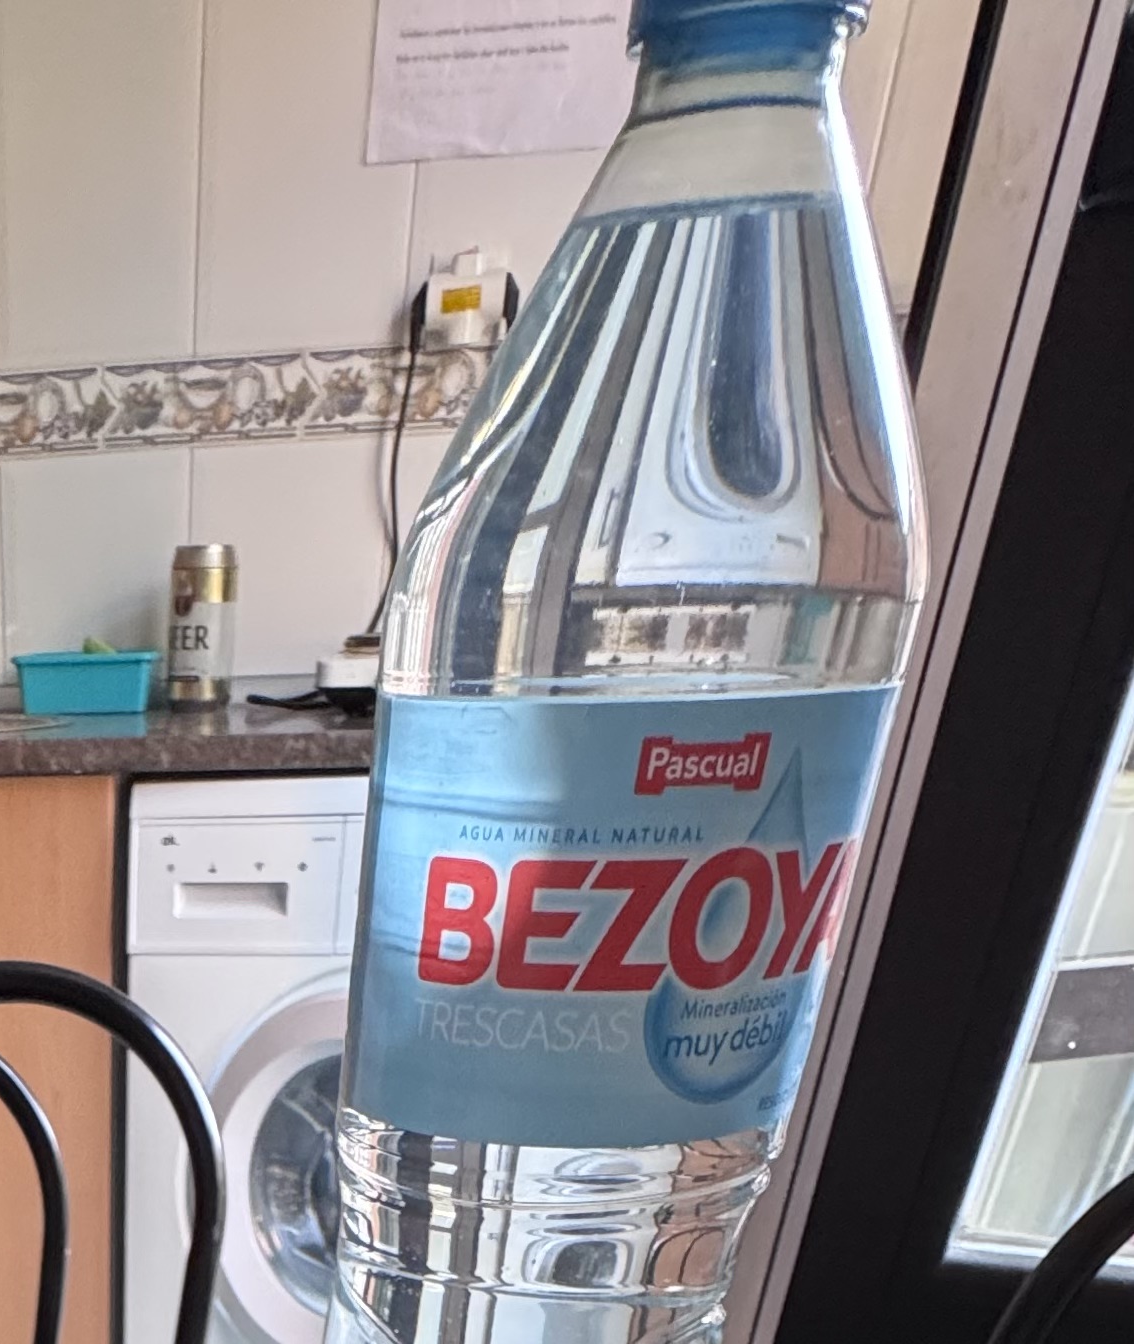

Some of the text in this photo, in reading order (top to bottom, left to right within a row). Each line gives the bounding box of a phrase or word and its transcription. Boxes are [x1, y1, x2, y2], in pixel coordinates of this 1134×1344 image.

[646, 743, 761, 781] Pascual
[459, 824, 706, 846] AGUA MINERAL NATURAL
[680, 990, 787, 1020] Mineralización
[414, 1000, 632, 1054] TRESCASAS
[664, 1010, 788, 1066] muy débil
